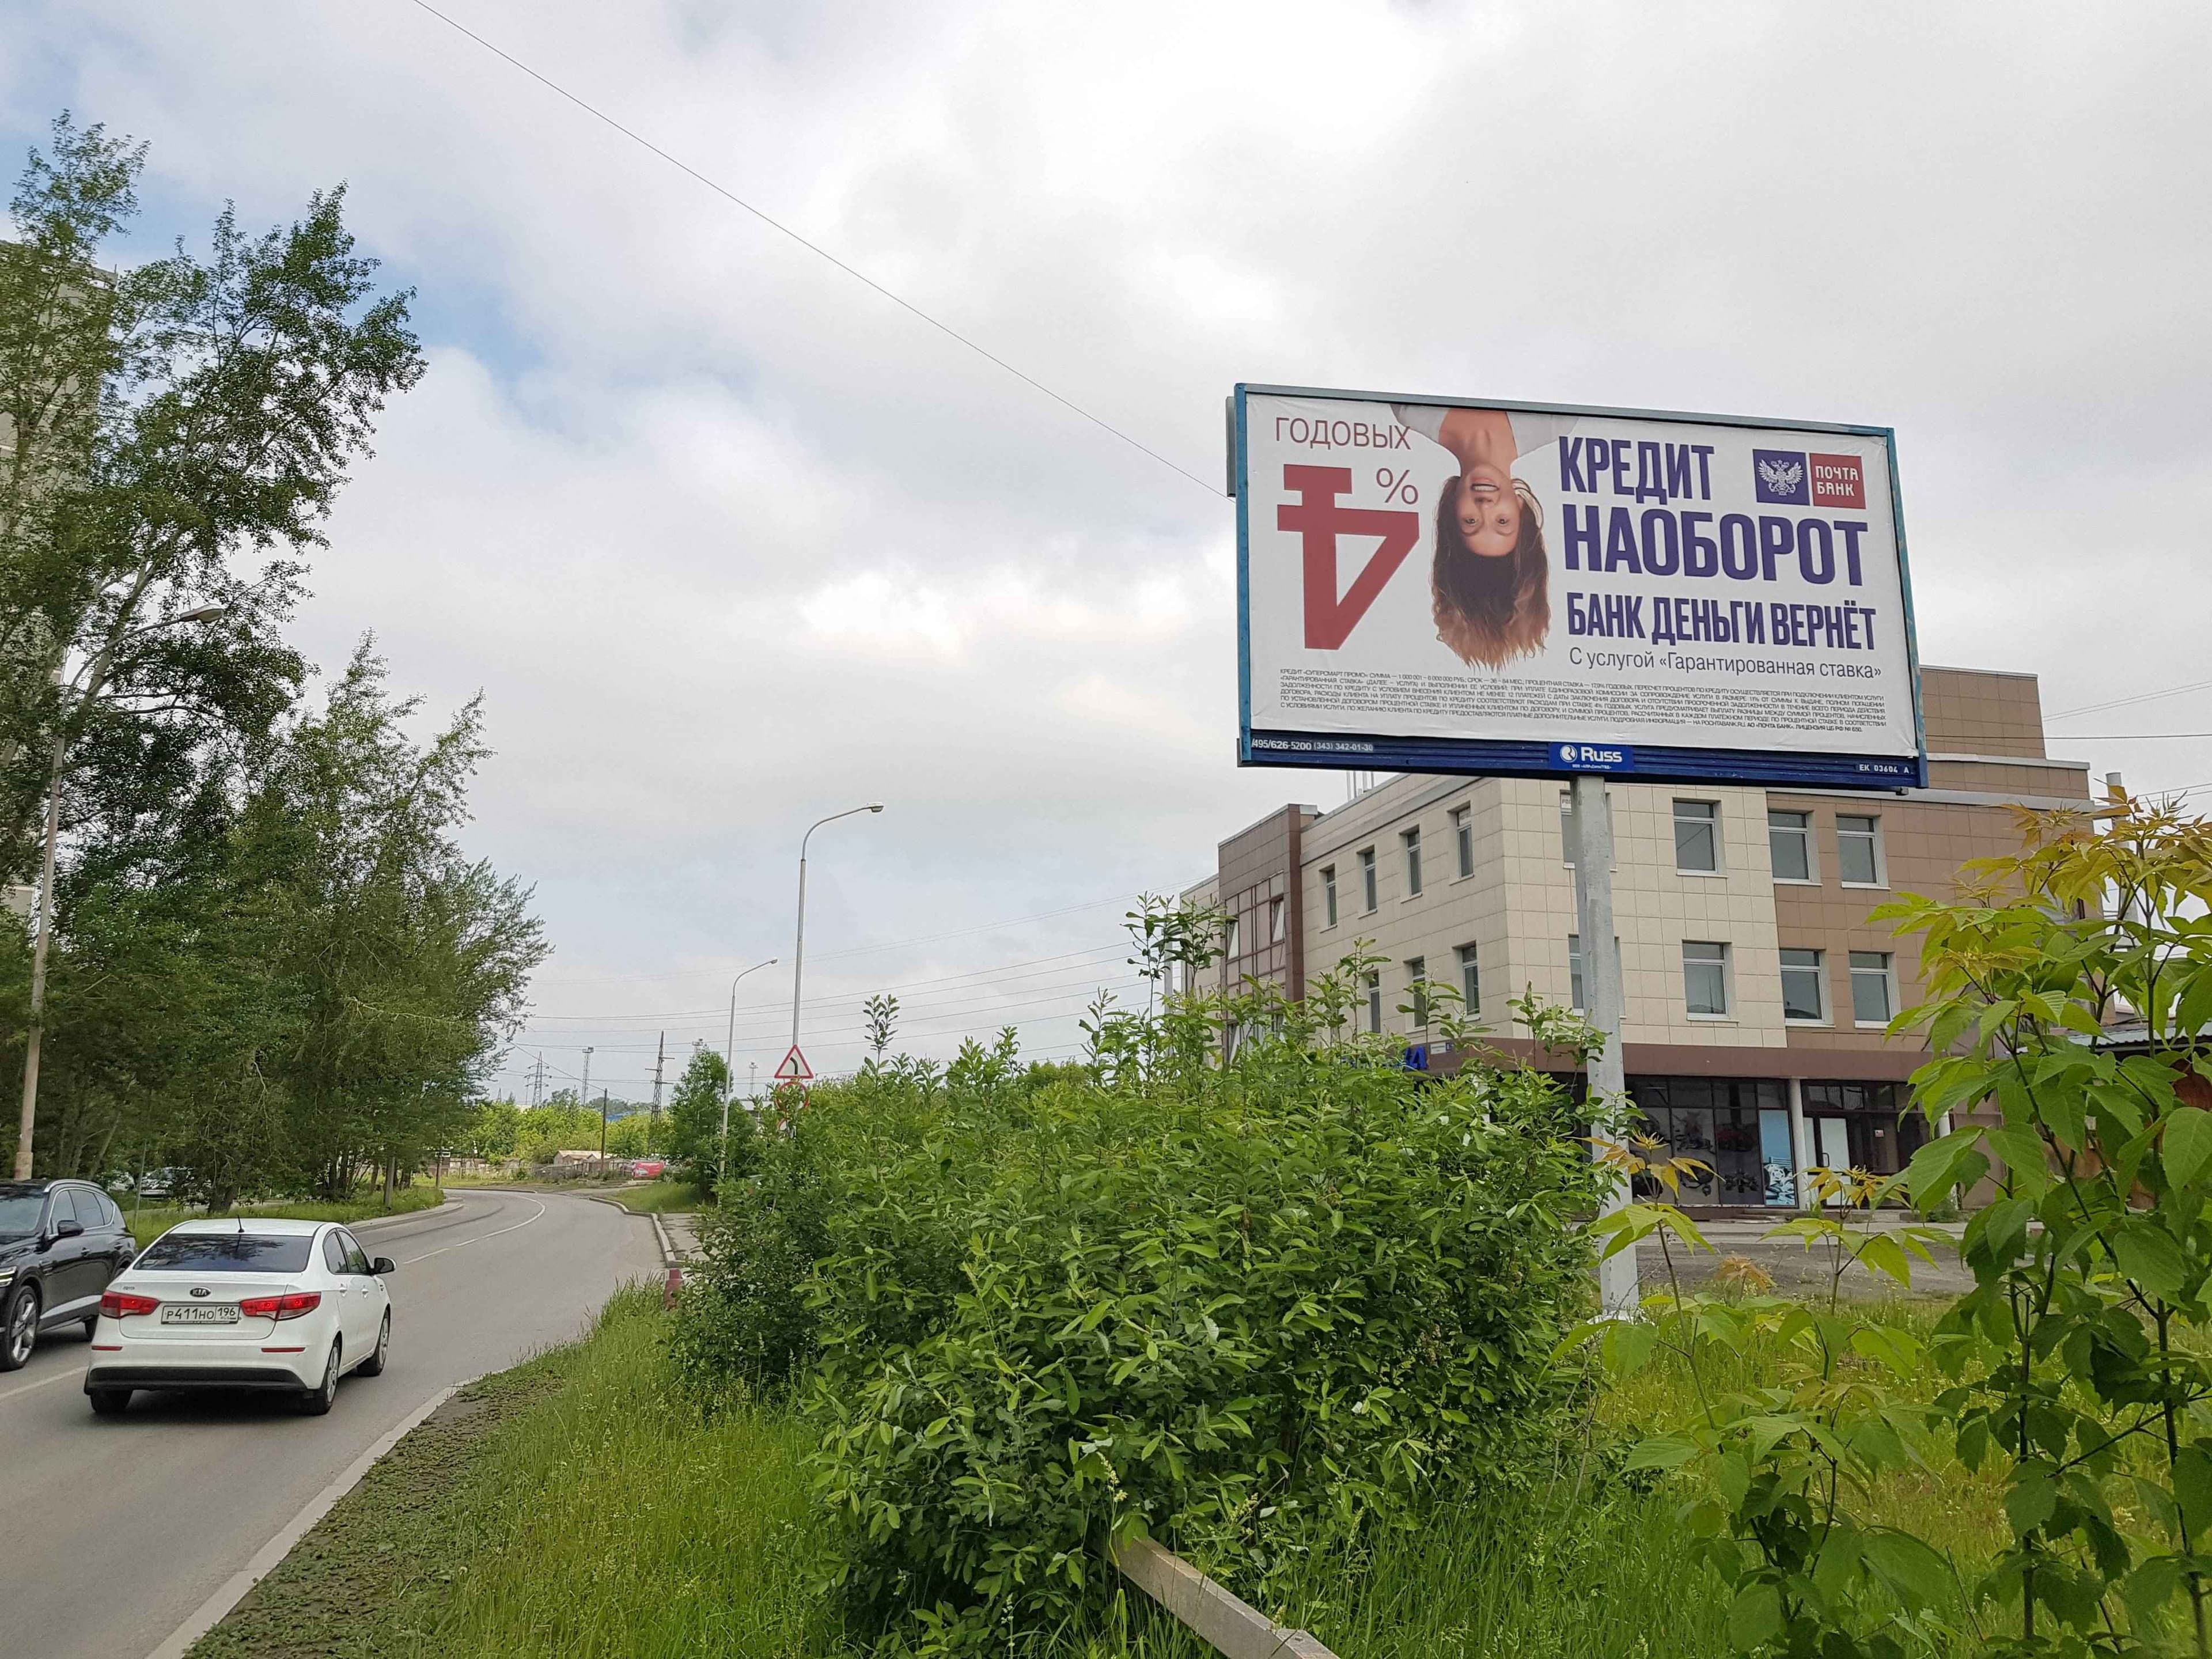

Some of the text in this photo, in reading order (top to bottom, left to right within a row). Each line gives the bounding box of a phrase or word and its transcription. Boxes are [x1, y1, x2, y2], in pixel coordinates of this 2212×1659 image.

[1276, 417, 1411, 450] ГОДОВЫХ
[1559, 436, 1714, 505] КРЕДИТ
[1815, 465, 1859, 480] ПОЧТА
[1376, 468, 1419, 505] %
[1816, 481, 1854, 496] БАНК
[1562, 503, 1868, 586] НАОБОРОТ
[1567, 592, 1876, 650] БАНК ДЕНЬГИ ВЕРНЁТ
[1570, 647, 1881, 678] С услугой «Гарантированная ставка»
[1335, 743, 1373, 752] 342-01-30
[1581, 747, 1622, 763] Russ
[217, 1308, 236, 1316] 196
